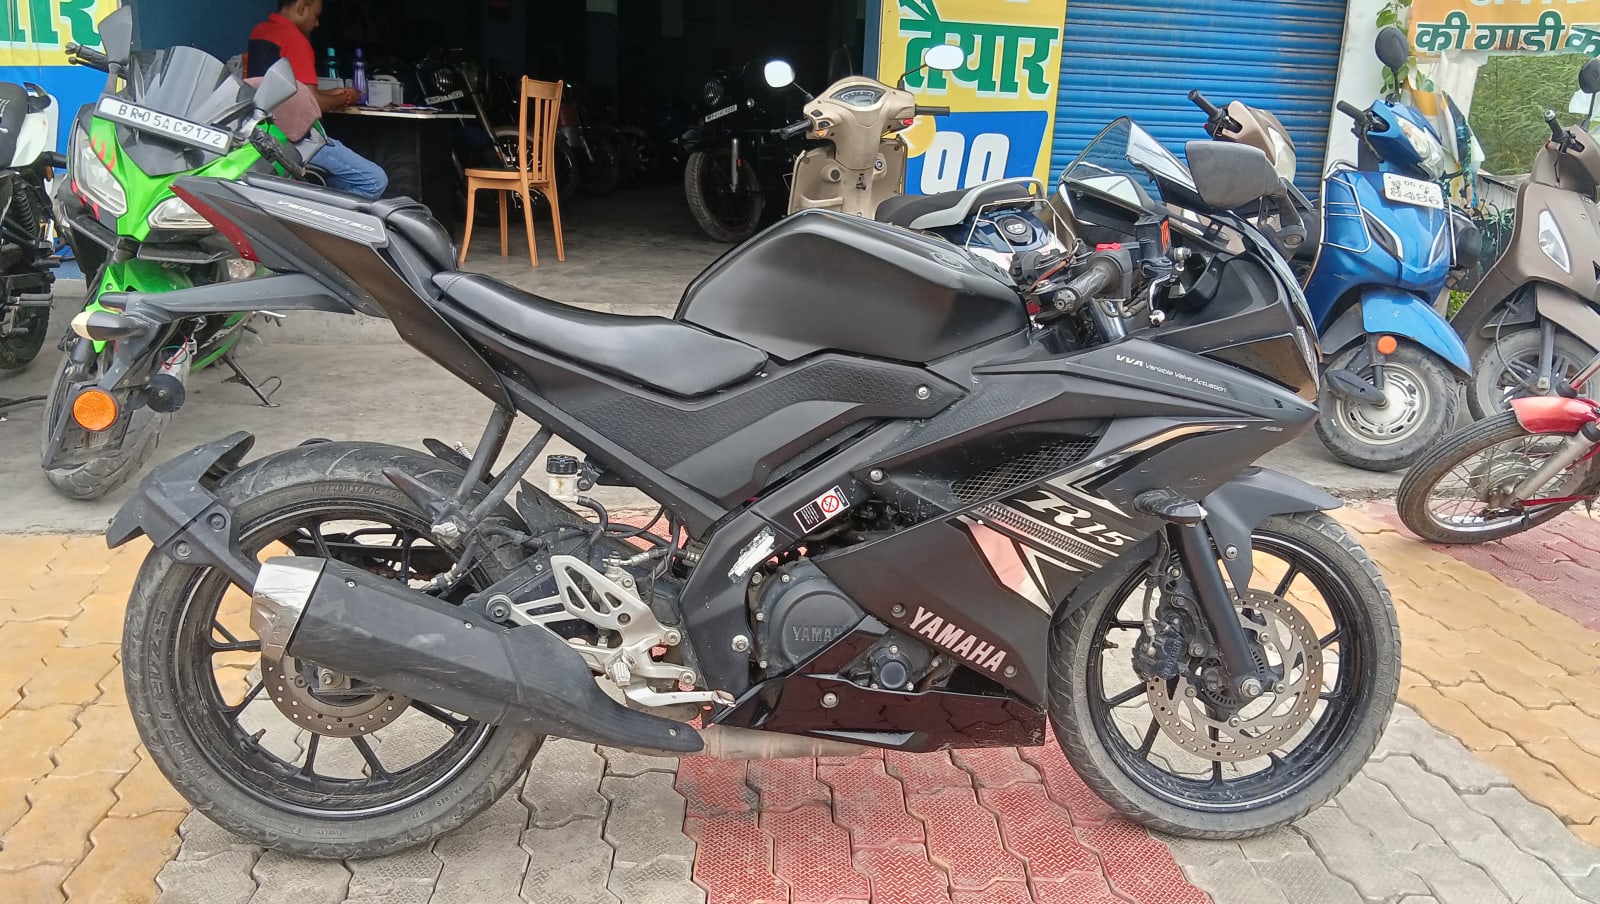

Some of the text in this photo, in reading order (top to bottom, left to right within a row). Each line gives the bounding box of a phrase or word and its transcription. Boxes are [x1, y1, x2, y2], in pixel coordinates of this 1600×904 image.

[1116, 354, 1227, 393] VVA Variable Valve Actuation
[1014, 490, 1139, 546] R15
[792, 624, 850, 642] YAMAH
[910, 606, 1007, 673] YAMAHA
